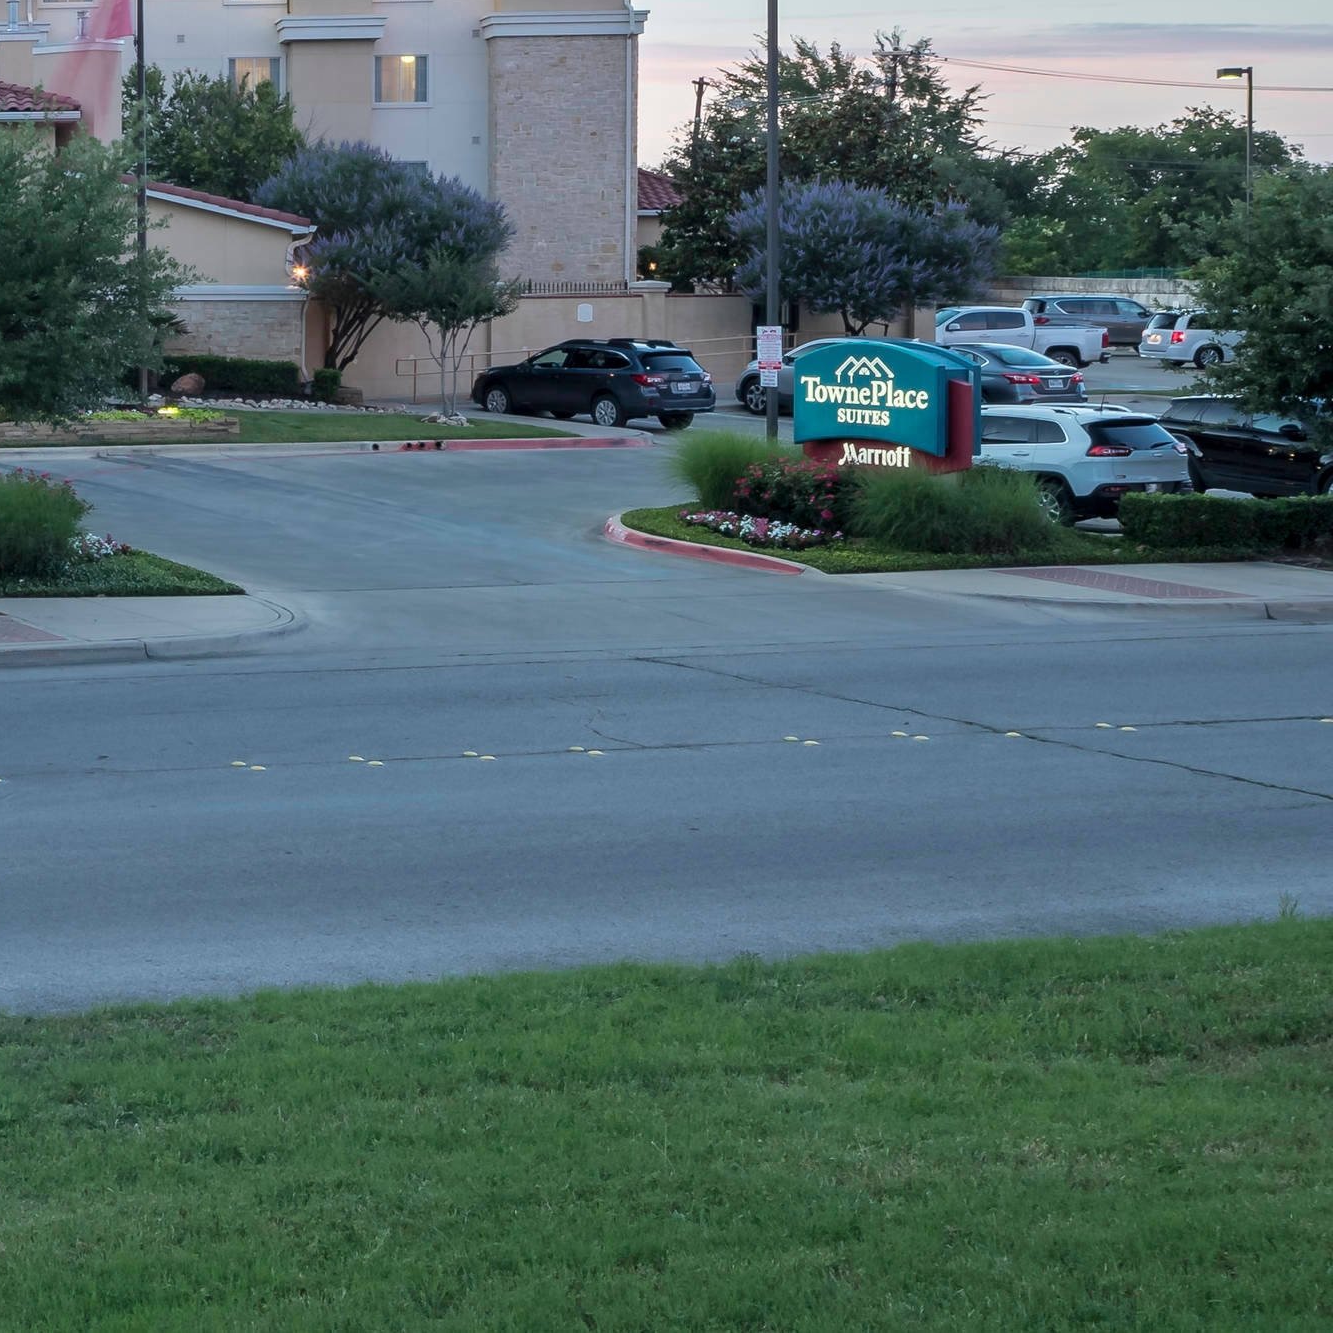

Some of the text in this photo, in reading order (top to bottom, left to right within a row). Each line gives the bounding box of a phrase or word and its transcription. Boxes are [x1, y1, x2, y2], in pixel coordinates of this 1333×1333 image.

[800, 376, 929, 409] TownePlace
[837, 408, 890, 426] SUITES
[838, 442, 911, 468] Marriott
